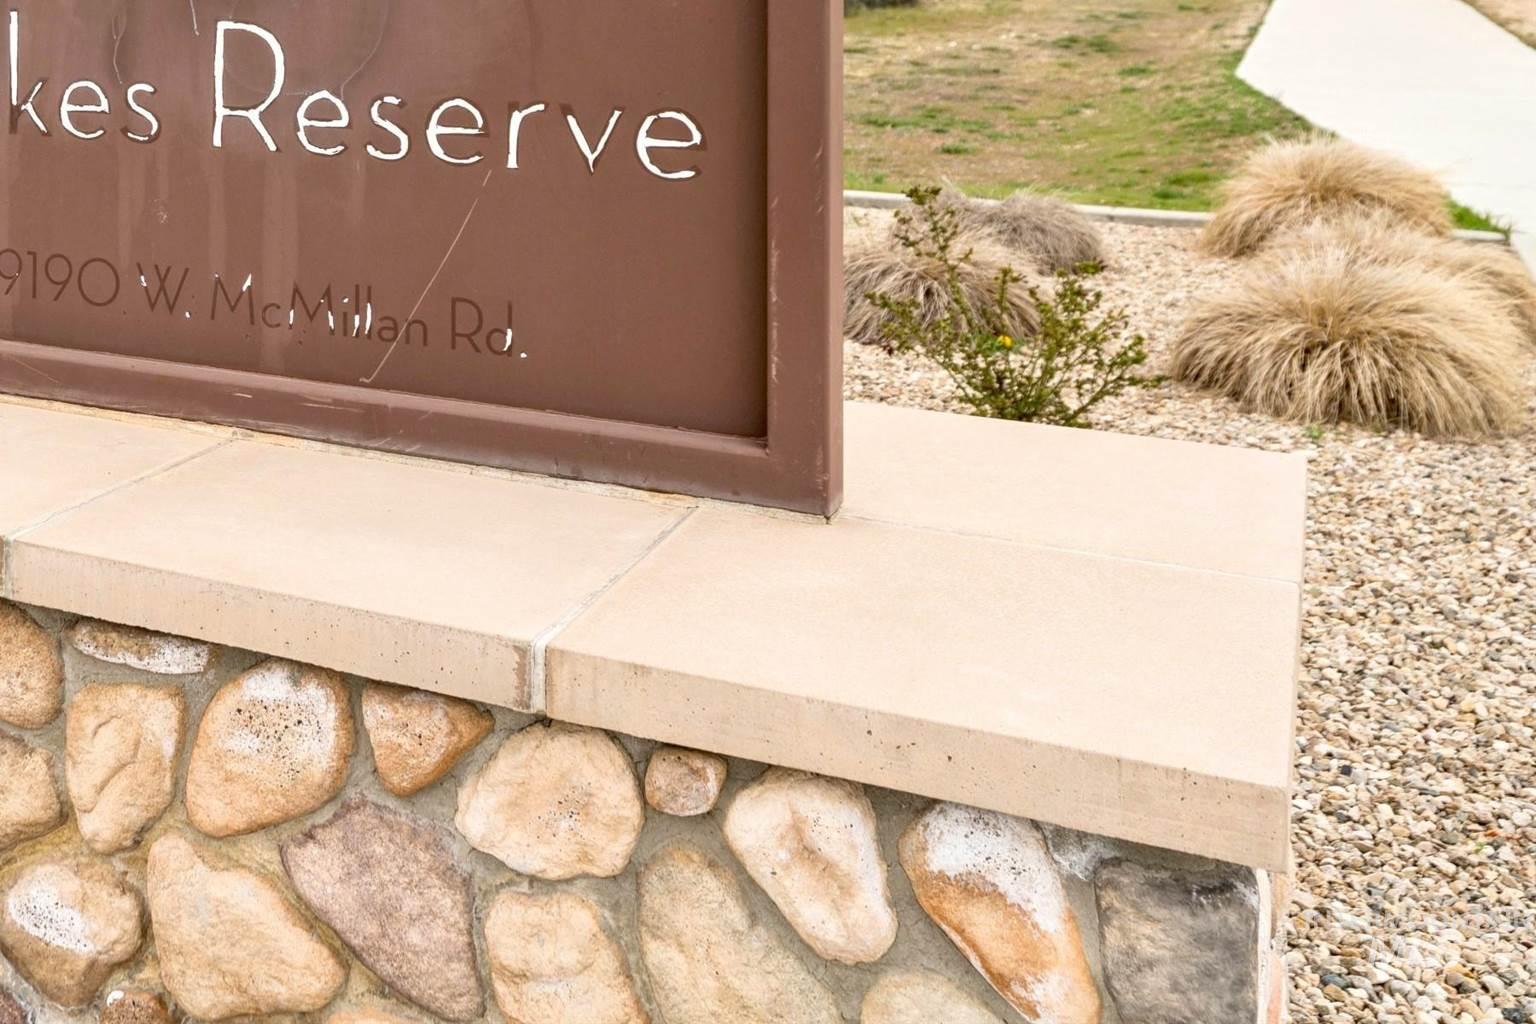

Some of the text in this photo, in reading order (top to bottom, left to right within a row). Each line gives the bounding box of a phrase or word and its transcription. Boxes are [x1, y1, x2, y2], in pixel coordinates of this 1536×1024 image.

[211, 20, 707, 180] Reserve
[136, 262, 192, 319] W.
[209, 274, 429, 348] McMillan
[449, 297, 528, 359] Rd.
